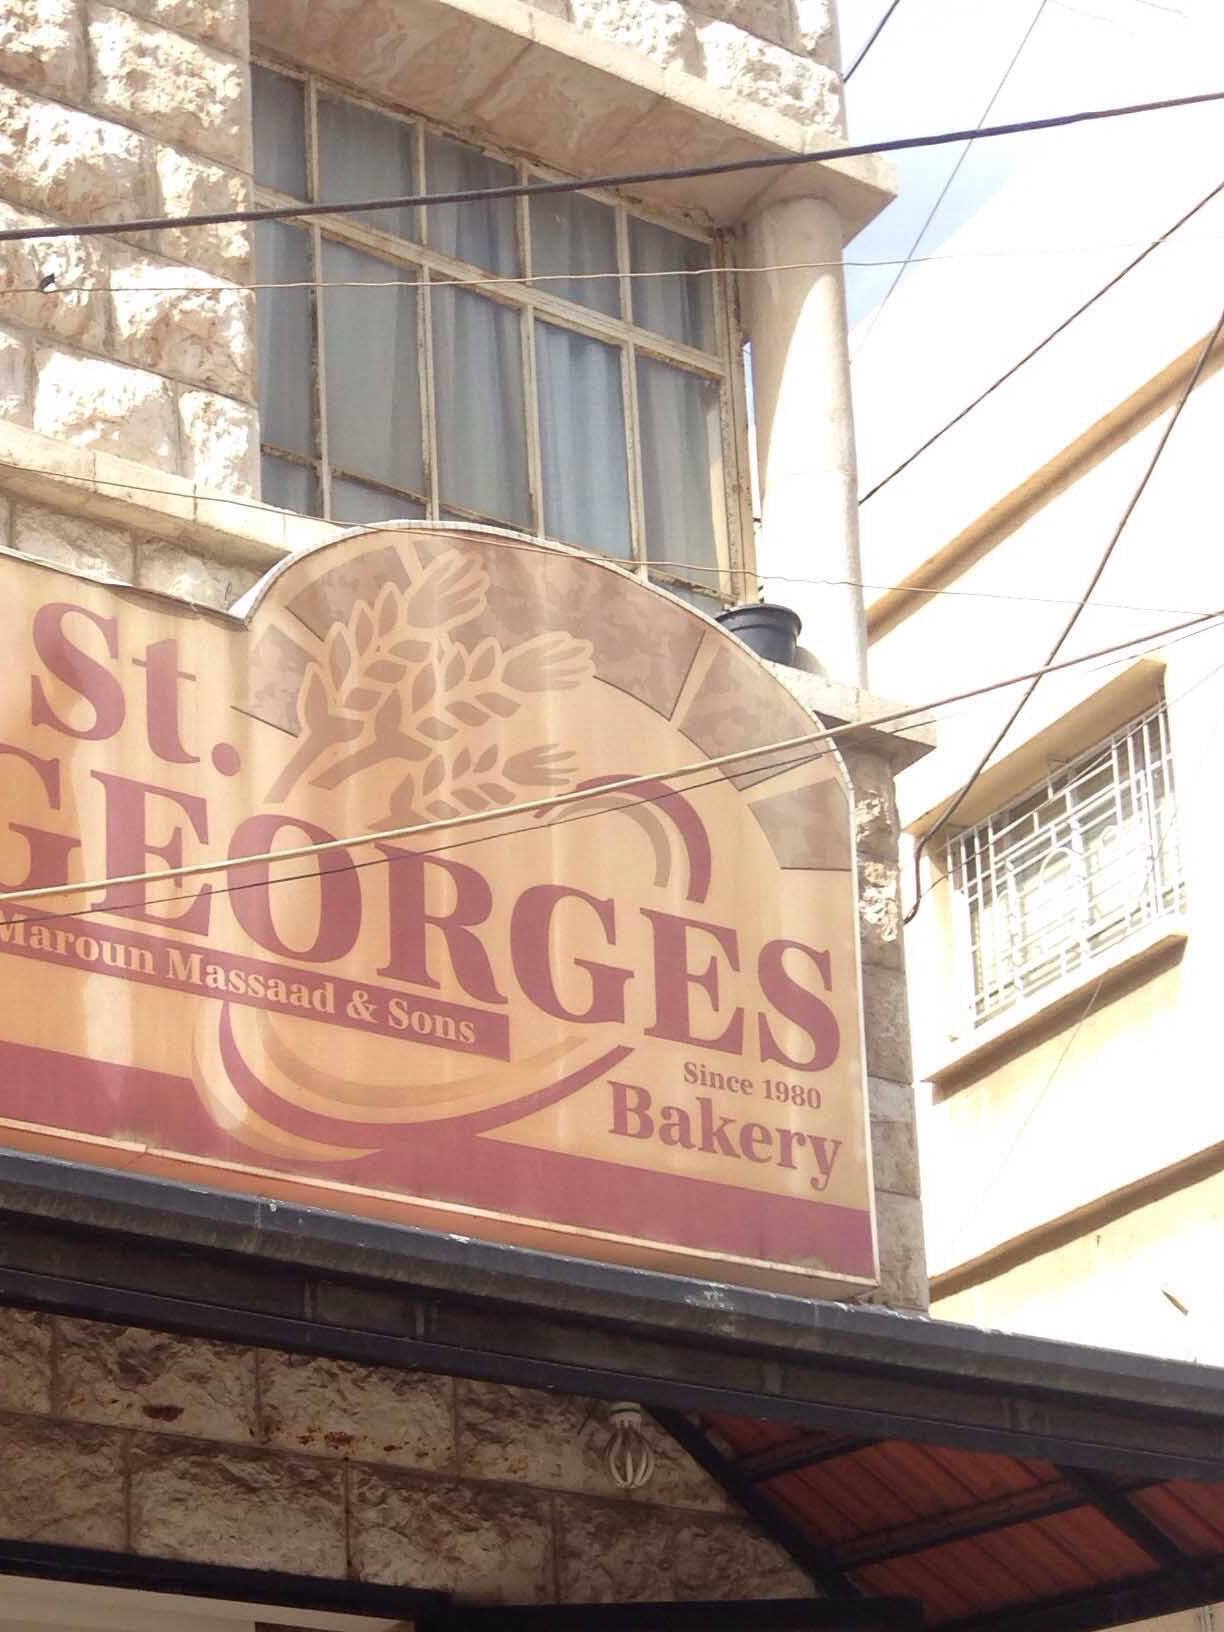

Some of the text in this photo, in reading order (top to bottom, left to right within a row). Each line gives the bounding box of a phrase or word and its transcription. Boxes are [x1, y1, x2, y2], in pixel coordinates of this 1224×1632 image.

[31, 602, 241, 776] St.
[166, 948, 335, 1015] Massaad
[345, 989, 379, 1024] &
[387, 998, 477, 1045] Sons
[607, 1080, 843, 1192] Bakery
[683, 1061, 822, 1110] Since 1980
